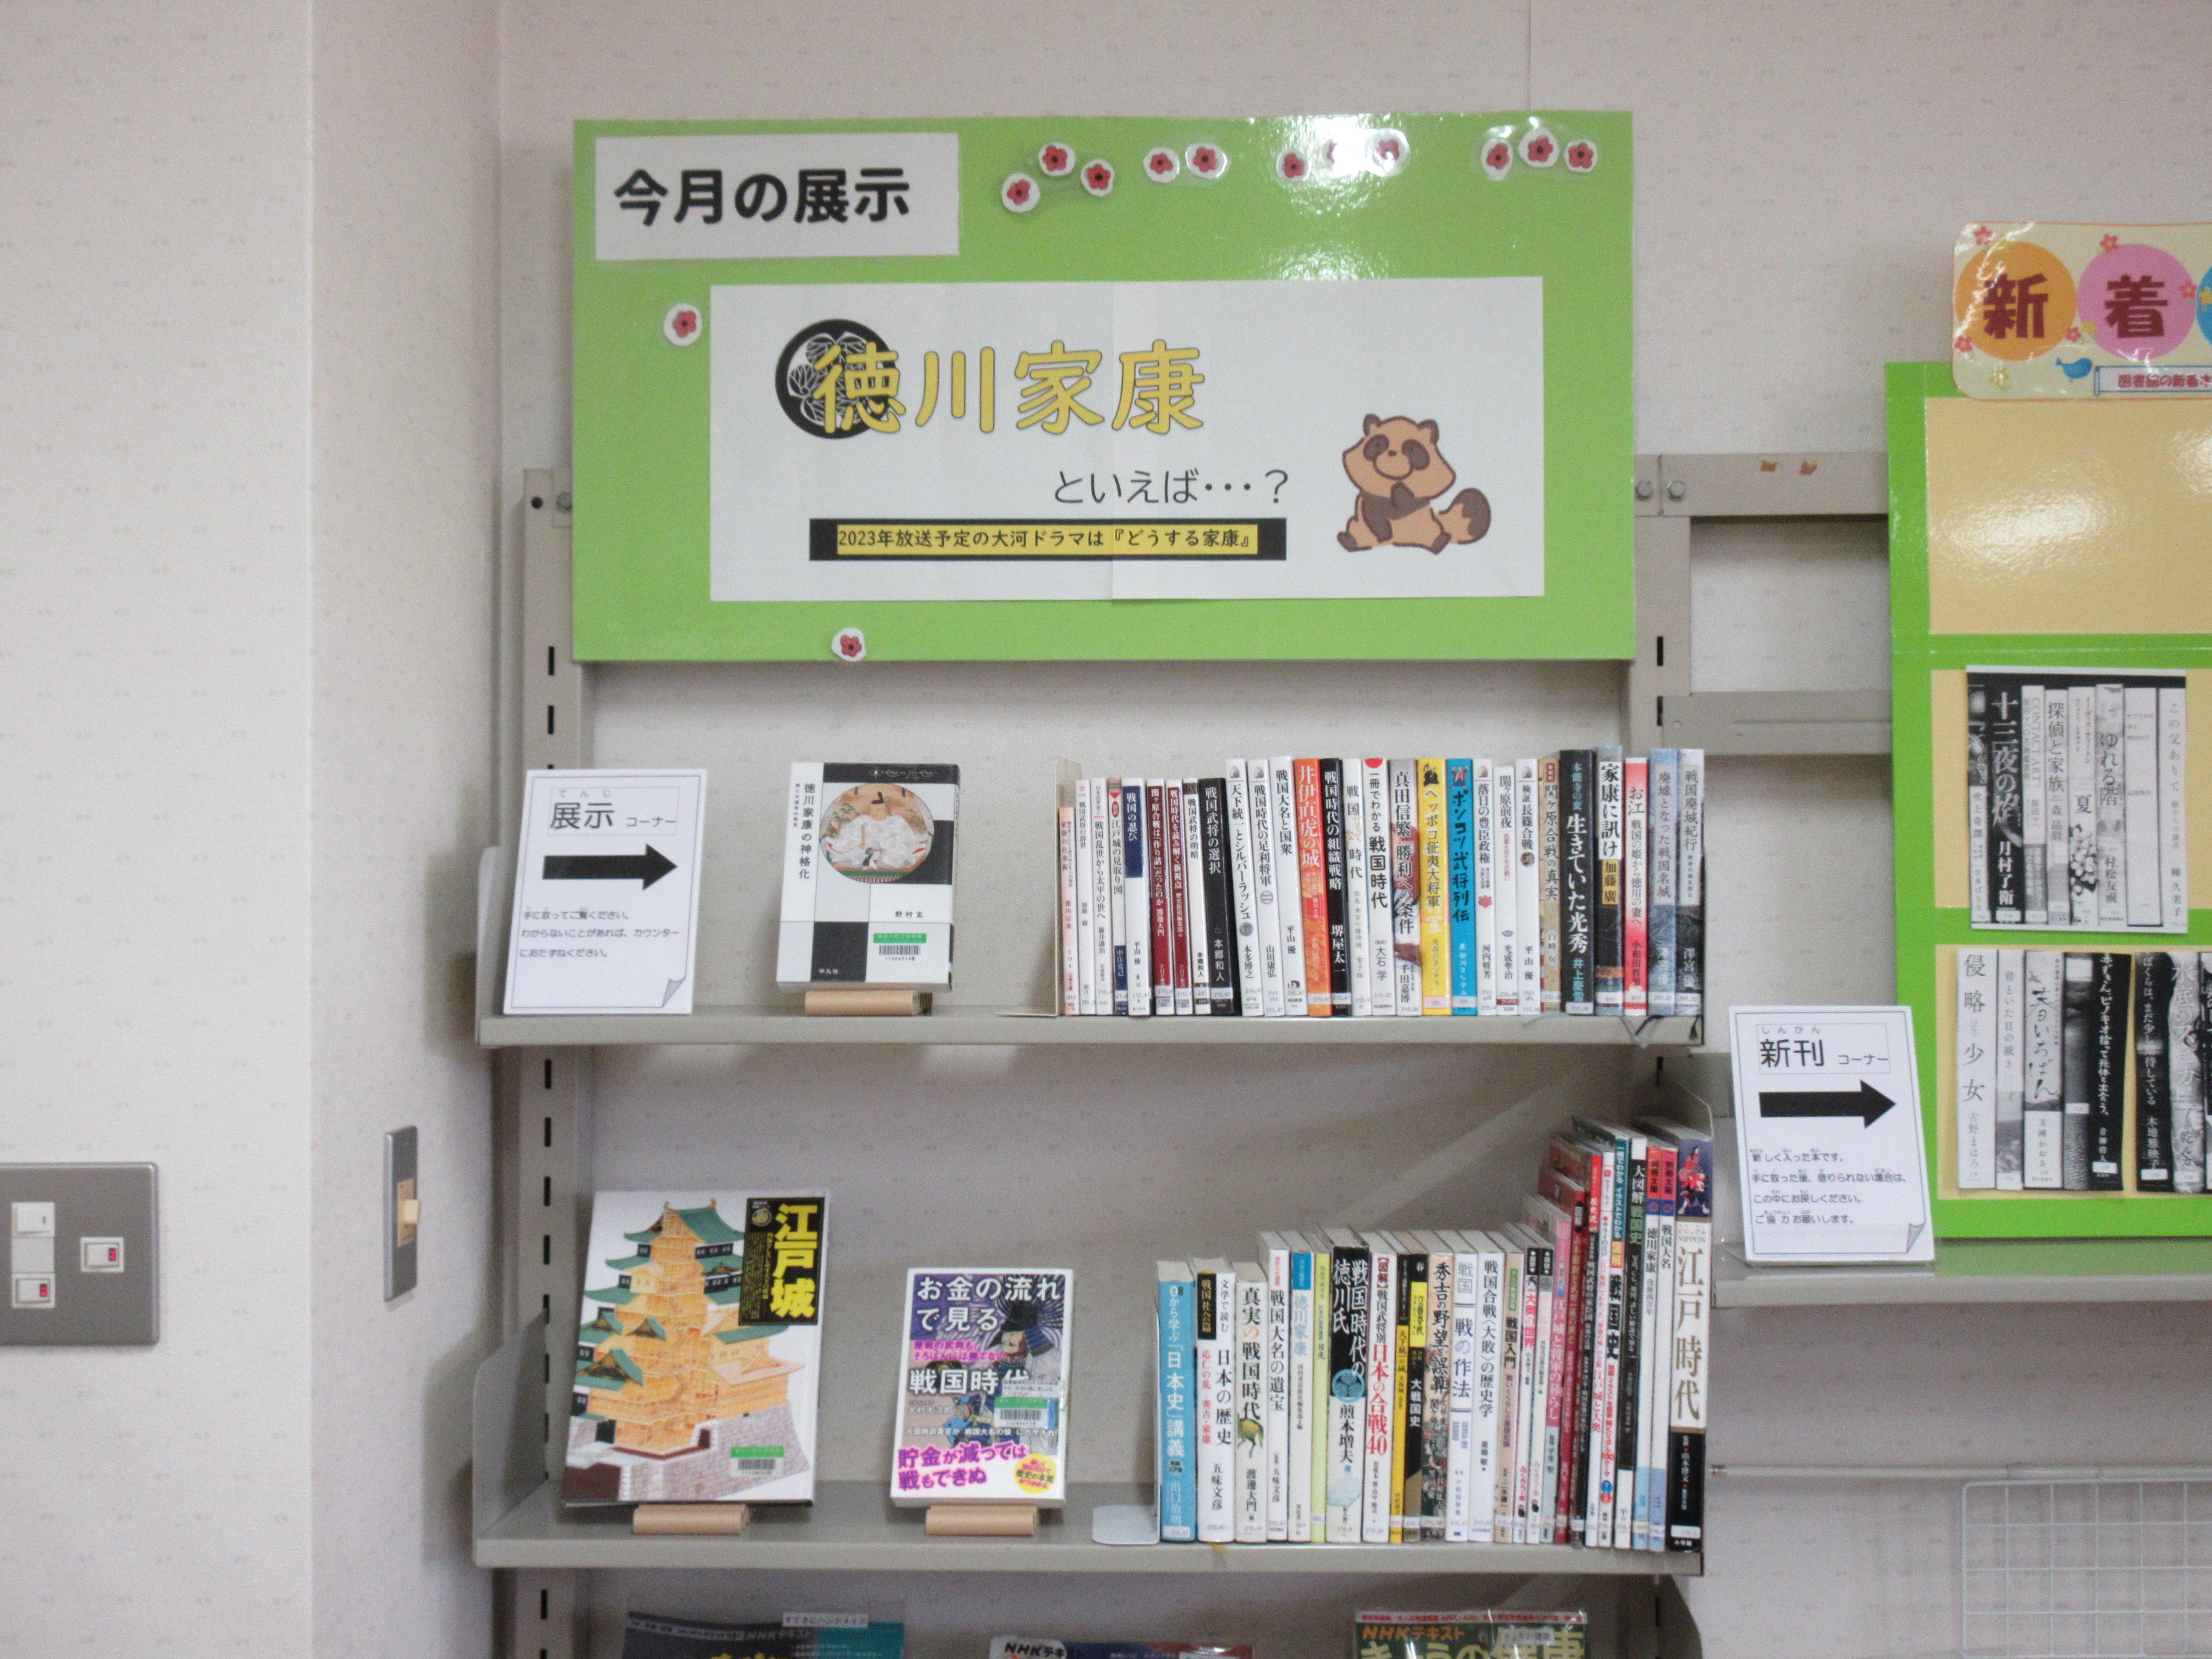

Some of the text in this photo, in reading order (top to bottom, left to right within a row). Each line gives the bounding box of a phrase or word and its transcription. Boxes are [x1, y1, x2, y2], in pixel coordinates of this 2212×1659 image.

[614, 168, 911, 226] 今月の展示
[811, 340, 1204, 434] 徳川家康
[837, 526, 1255, 551] 2023年放送予定の大河ドラマは『どうする家康』
[1572, 763, 1583, 810] 本能寺の変
[2048, 703, 2064, 792] 探偵と家族
[2100, 733, 2118, 806] ゆれる階
[550, 803, 677, 829] 展示 コーナー
[799, 783, 816, 879] 徳川家康の神格化
[1126, 792, 1138, 841] 戦国の忍び
[1170, 789, 1182, 889] 戦国時代を読み解く新視点
[1205, 786, 1221, 874] 戦国武将の選択
[1254, 785, 1272, 886] 戦国時代の足利将軍
[1276, 770, 1292, 855] 戦国大名と国衆
[1299, 766, 1320, 867] 井伊直虎の城
[1324, 771, 1343, 890] 戦国時代の組織戦略
[1369, 773, 1388, 909] 一冊でわかる 戦国時代
[1394, 771, 1411, 837] 真田信繁
[1478, 783, 1491, 864] 落日の豊臣政権
[1500, 775, 1512, 829] 関ヶ原前夜
[1522, 804, 1534, 850] 長篠合戦
[1544, 786, 1559, 900] 関ヶ原合戦の真実
[1601, 764, 1621, 857] 家康に訊け
[1628, 786, 1645, 816] お江
[1658, 772, 1672, 898] 廃墟となった戦国名城
[1683, 770, 1699, 851] 戦国廃城紀行
[1094, 821, 1106, 918] 戦国乱世から太平の世へ
[1111, 820, 1122, 894] 江戸城の見取り図
[1231, 785, 1251, 920] 天下統一とシルバーラッシュ
[1424, 788, 1440, 908] ヘッポコ征夷大将軍
[1453, 789, 1470, 923] ポンコツ武将列伝
[1566, 814, 1589, 955] 生きていた光秀
[1631, 820, 1643, 924] 戦国の姫から徳川の妻へ
[519, 949, 608, 958] におたずねください。
[521, 928, 679, 938] わからないことがあれば、カウンター
[1214, 939, 1225, 981] 本郷和人
[1244, 945, 1253, 979] 本多博之
[1266, 945, 1276, 978] 山田康弘
[1331, 924, 1345, 972] 堺屋太一
[1760, 1039, 1889, 1067] 新刊 コーナー
[1962, 955, 1985, 1101] 侵略少女
[2143, 957, 2157, 1105] ぼくらは、まだ少し待している
[1752, 1153, 1845, 1162] 新しく入った本です。
[1753, 1194, 1862, 1204] この中にお戻しください。
[770, 1204, 818, 1318] 江戸城
[917, 1276, 1061, 1301] お金の流れ
[1333, 1259, 1351, 1334] 徳川氏
[917, 1307, 998, 1332] で見る
[1243, 1287, 1261, 1420] 真実の戦国時代
[1270, 1290, 1285, 1411] 戦国大名の遺宝
[1350, 1259, 1368, 1377] 戦国時代の
[1452, 1261, 1473, 1398] 戦国 戦の作法
[1480, 1260, 1499, 1417] 戦国合戦〈大敗〉の歴史学
[1675, 1247, 1704, 1420] 江戸時代
[1216, 1350, 1232, 1445] 日本の歴史
[1366, 1345, 1389, 1455] 日本の合戦40
[1410, 1378, 1423, 1427] 大戦国史
[898, 1441, 1028, 1469] 貯金が減っては
[899, 1467, 987, 1490] 戦もできぬ
[1362, 1626, 1466, 1640] NHKテキスト
